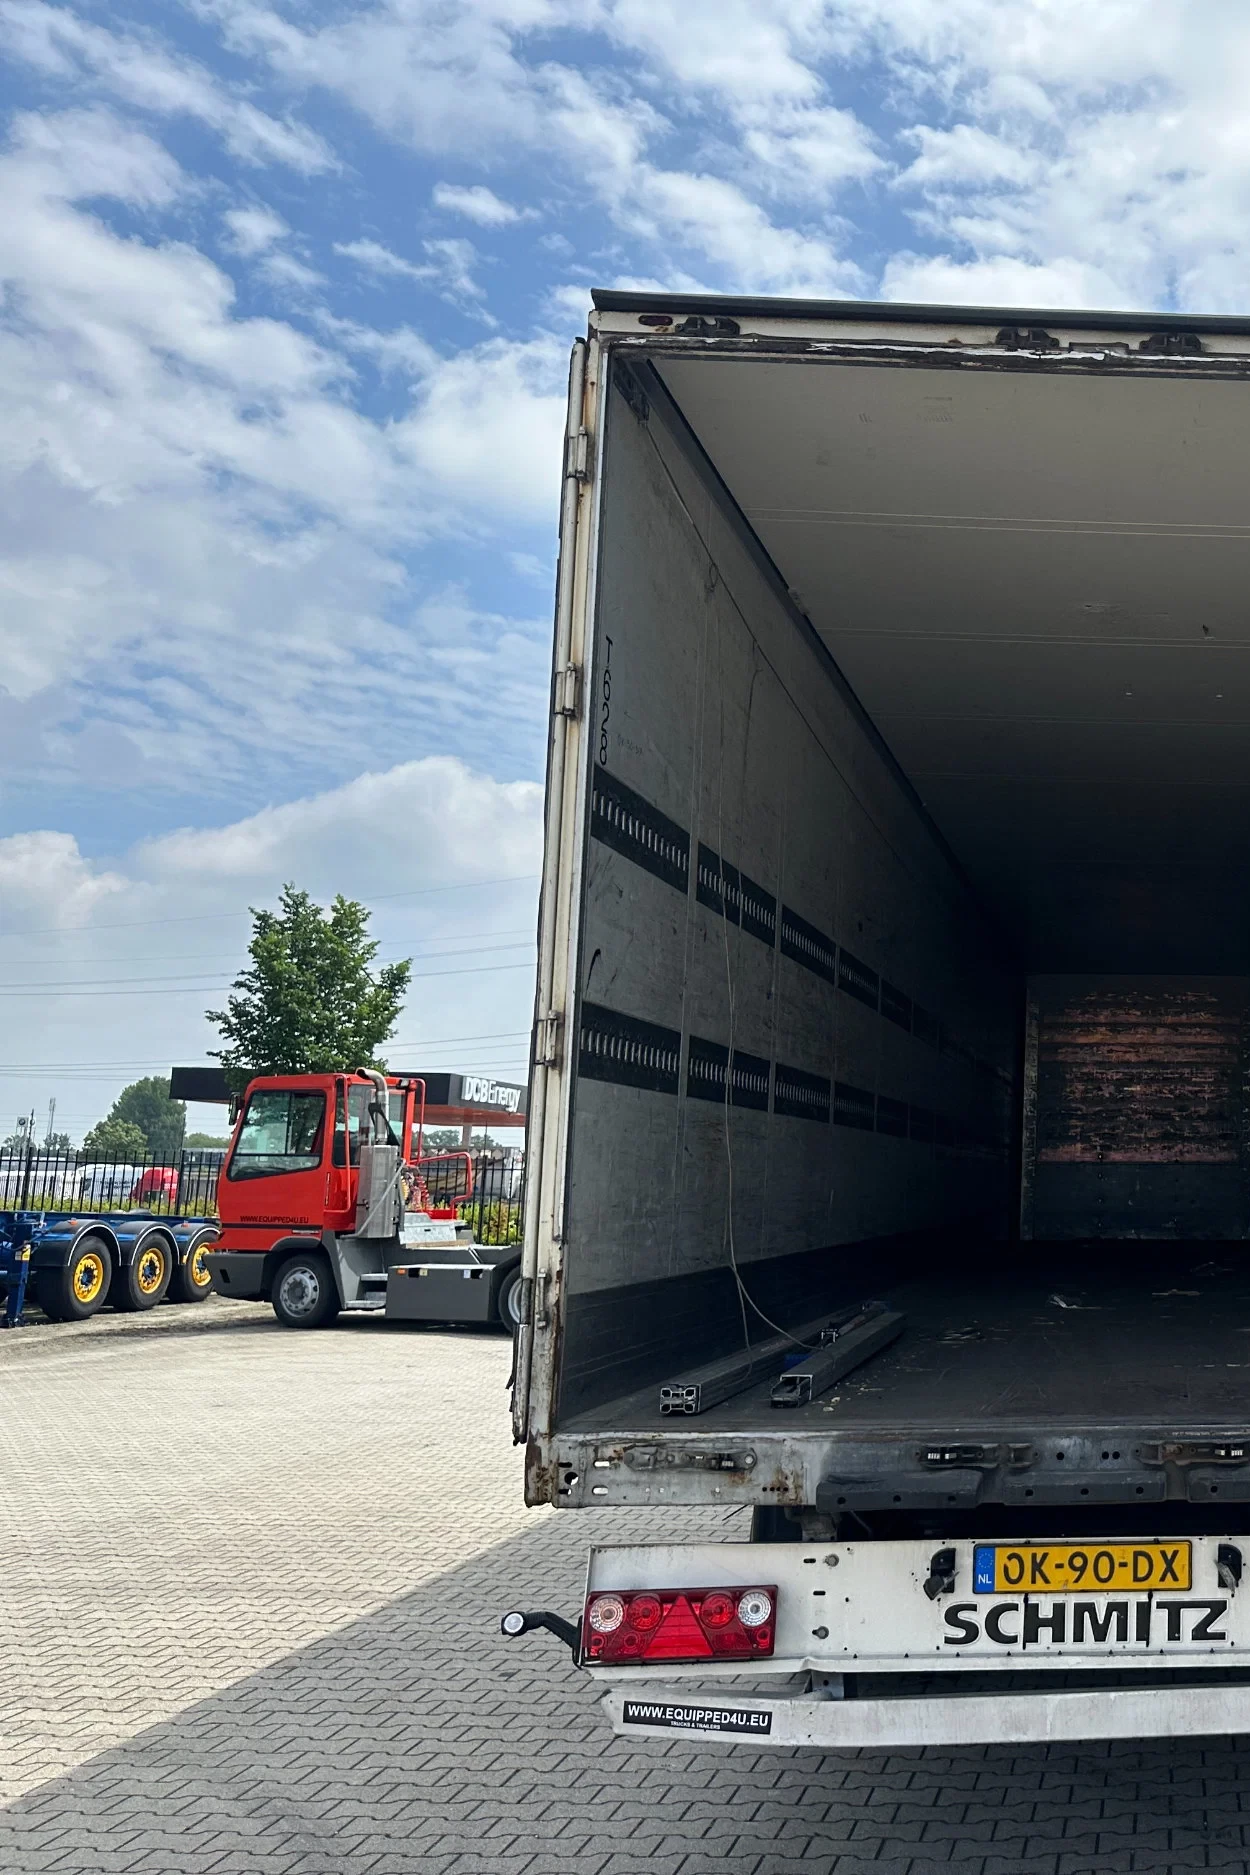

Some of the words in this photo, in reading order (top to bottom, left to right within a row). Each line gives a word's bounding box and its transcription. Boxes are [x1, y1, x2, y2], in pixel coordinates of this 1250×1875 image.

[240, 1215, 309, 1224] WWW.EQUIPPED4U.EU
[1002, 1549, 1180, 1585] OK-90-DX
[977, 1574, 992, 1584] NL
[943, 1600, 1229, 1645] SCHMITZ
[628, 1704, 769, 1727] WWW.EQUIPPED4U.EU
[670, 1720, 691, 1728] TRUCKS
